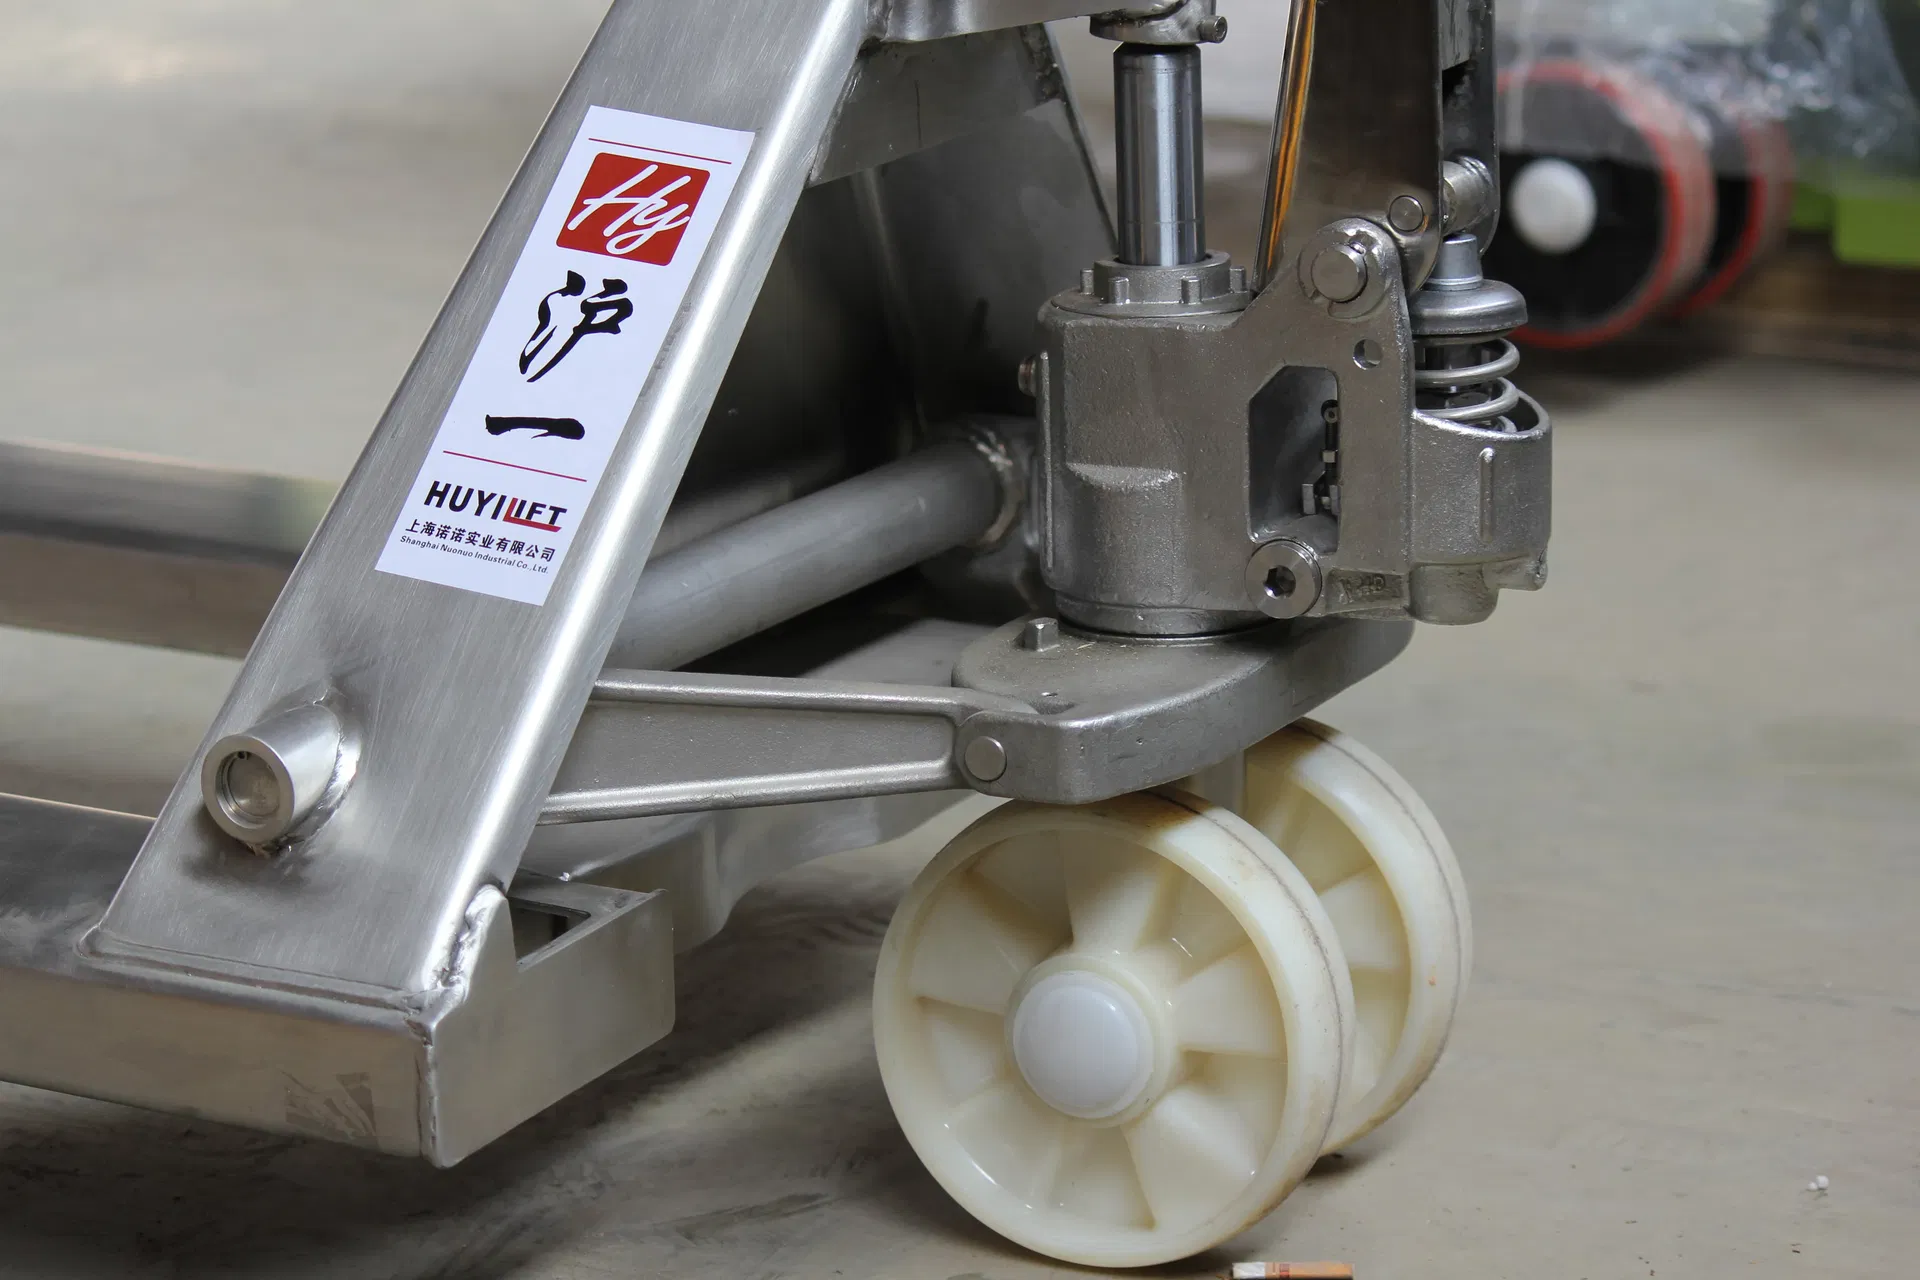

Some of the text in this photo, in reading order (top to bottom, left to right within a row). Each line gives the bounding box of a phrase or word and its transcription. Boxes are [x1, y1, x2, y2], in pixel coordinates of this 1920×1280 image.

[424, 480, 567, 532] HUYILIFT
[400, 535, 439, 551] Shanghai
[440, 544, 473, 557] Nuonuo
[474, 551, 516, 567] Industrial
[405, 518, 556, 562] 上海诺诺实业有限公司
